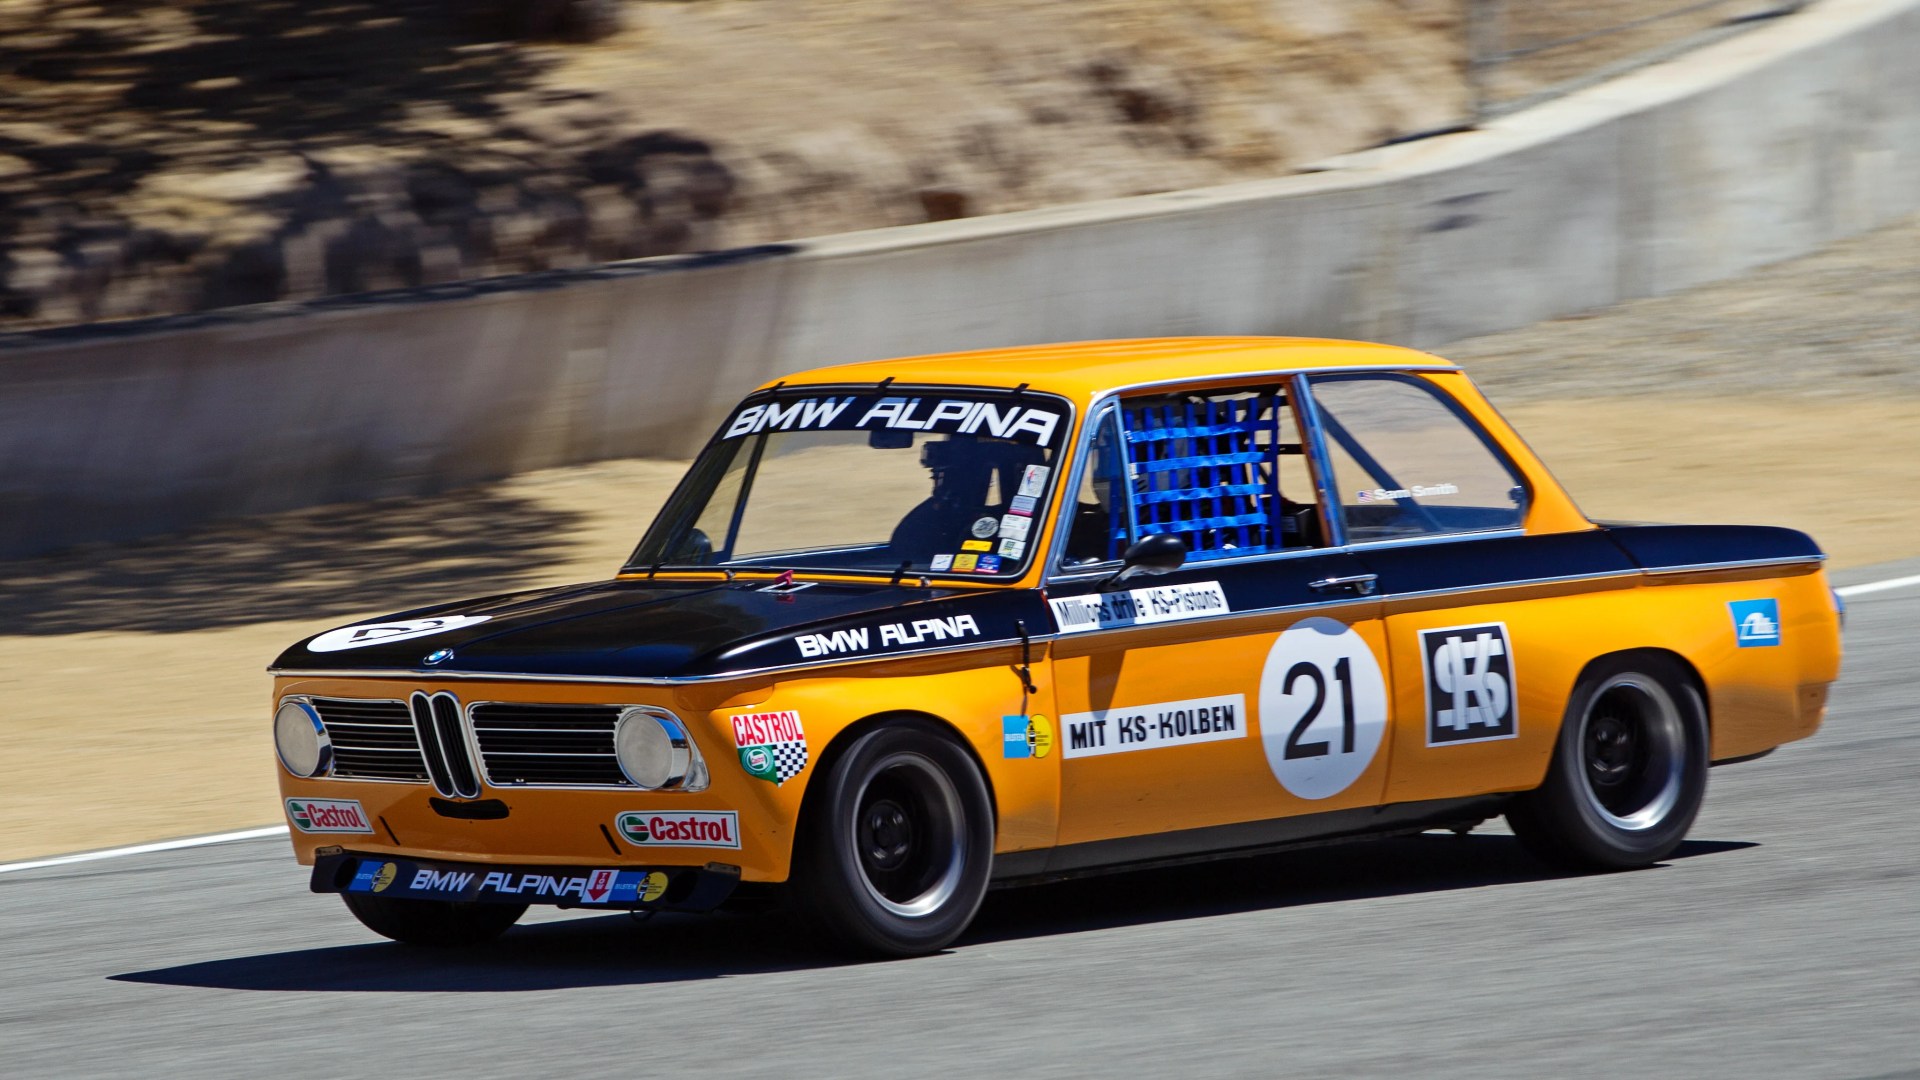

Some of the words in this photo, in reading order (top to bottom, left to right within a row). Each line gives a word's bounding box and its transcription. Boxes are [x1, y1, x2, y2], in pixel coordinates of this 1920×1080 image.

[723, 396, 856, 440] BMW
[856, 396, 1061, 447] ALPINA
[1374, 488, 1410, 500] Sam
[1411, 483, 1459, 497] Smith
[1056, 597, 1111, 627] Millions
[1111, 593, 1146, 620] drive
[795, 627, 869, 658] BMW
[879, 614, 982, 647] ALPINA
[1281, 656, 1356, 761] 21
[732, 711, 804, 747] CASTROL
[1069, 719, 1107, 750] MIT
[1118, 704, 1236, 744] KS-KOLBEN
[307, 803, 366, 828] Castrol
[649, 816, 733, 842] Castrol
[409, 869, 476, 892] BMW
[478, 871, 589, 898] ALPINA
[596, 872, 608, 890] TOW
